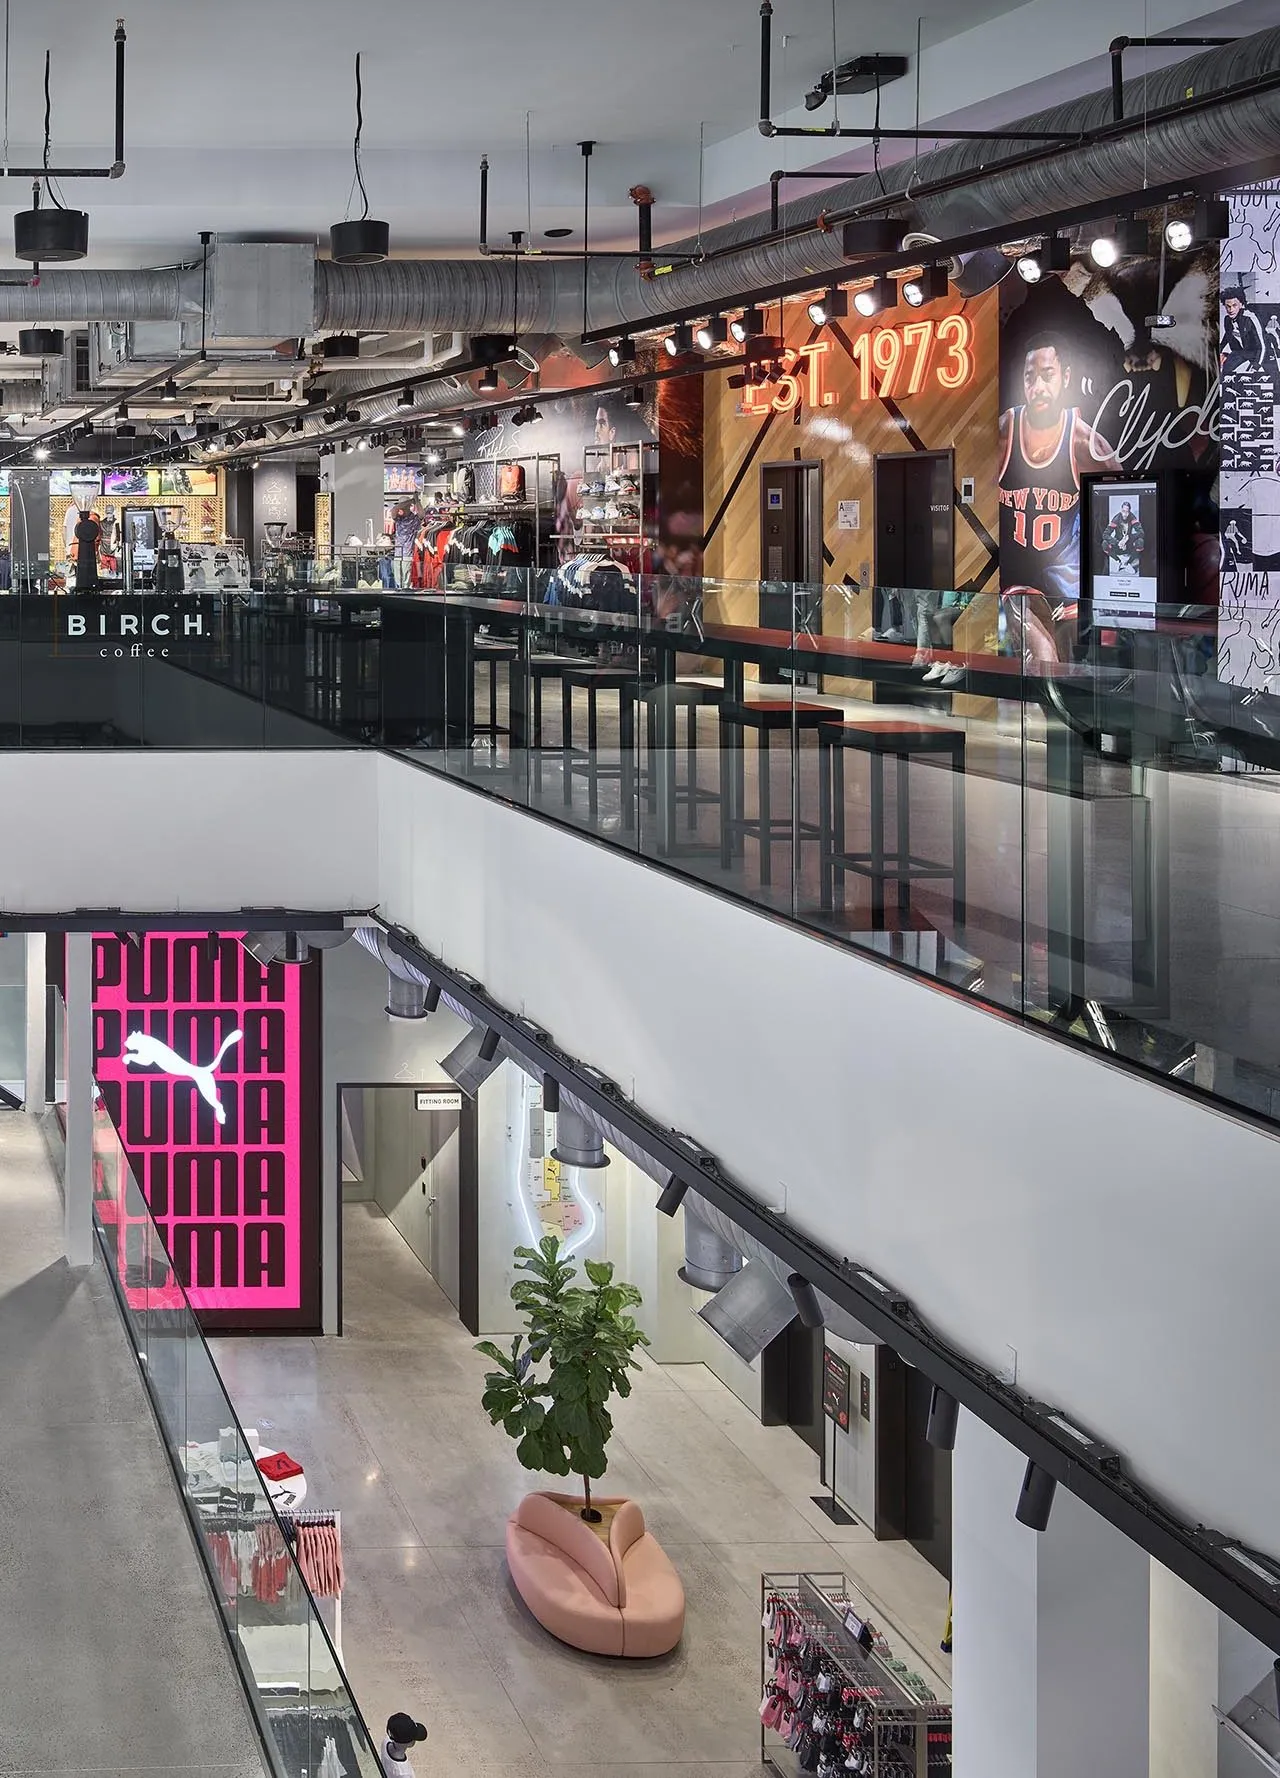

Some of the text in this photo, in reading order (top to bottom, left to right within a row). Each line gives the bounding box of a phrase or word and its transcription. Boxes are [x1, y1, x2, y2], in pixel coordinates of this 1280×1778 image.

[853, 314, 969, 401] 1973
[1013, 511, 1062, 551] 10
[99, 643, 169, 657] coffee
